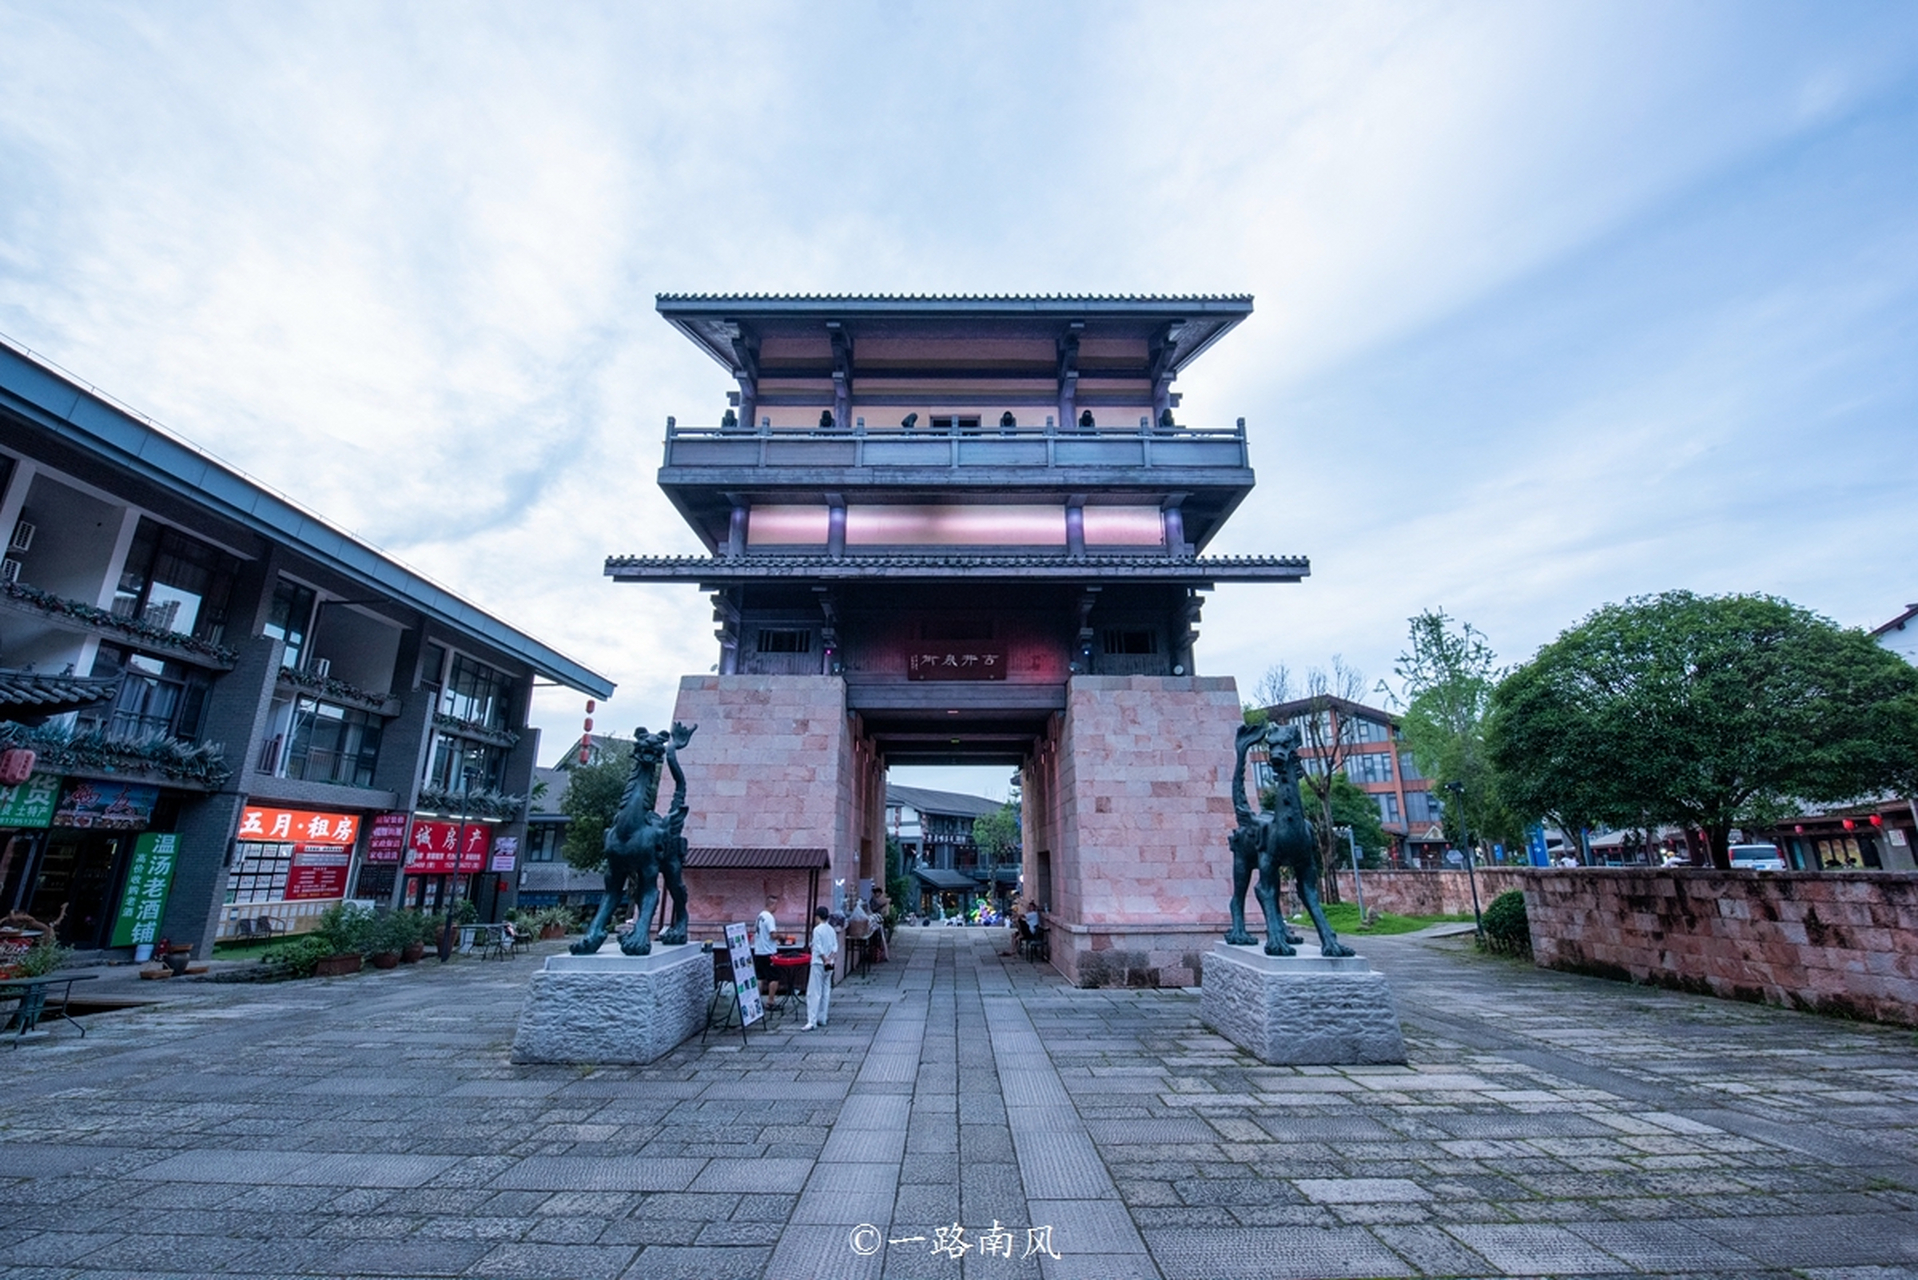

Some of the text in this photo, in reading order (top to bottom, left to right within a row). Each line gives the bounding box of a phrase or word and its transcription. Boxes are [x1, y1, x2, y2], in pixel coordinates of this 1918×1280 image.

[131, 833, 176, 944] 温汤老酒铺
